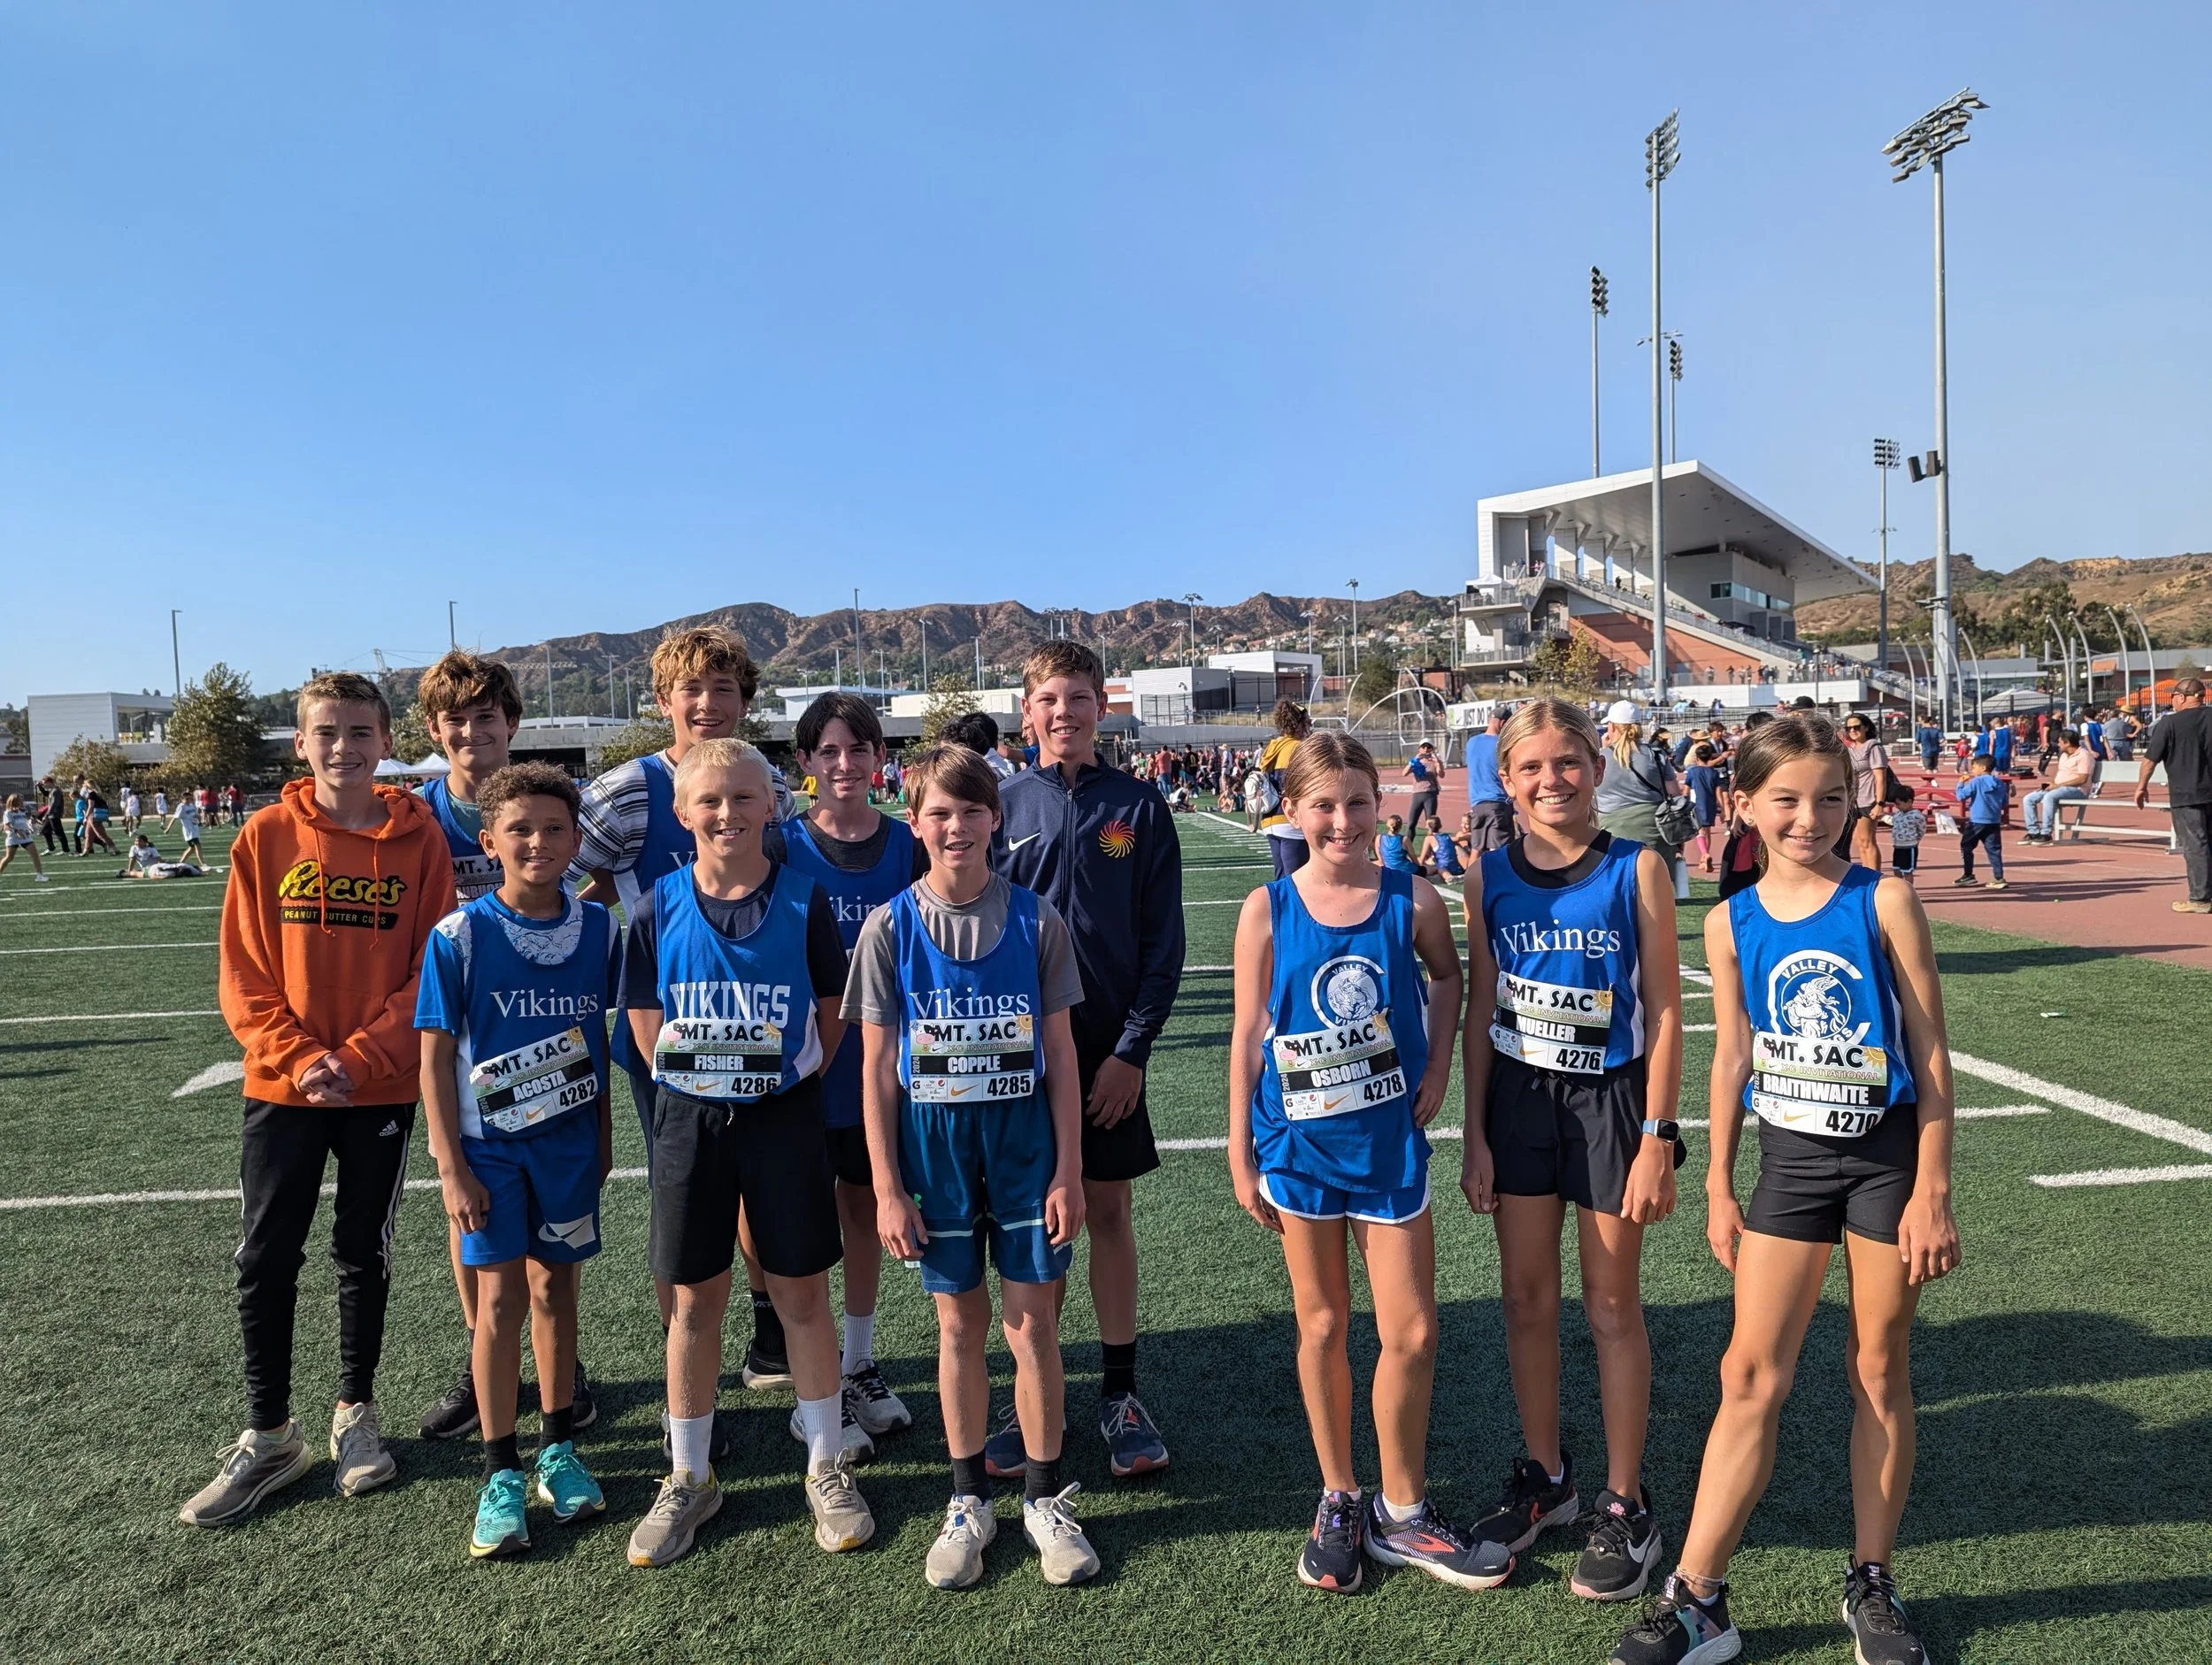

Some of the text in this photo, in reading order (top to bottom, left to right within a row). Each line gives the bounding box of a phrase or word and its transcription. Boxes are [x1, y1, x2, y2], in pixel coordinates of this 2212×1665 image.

[1463, 709, 1475, 725] JUST
[1478, 708, 1485, 725] DO
[362, 915, 386, 925] CUS
[1501, 919, 1621, 958] Vikings
[1332, 964, 1369, 975] VALLEY
[1781, 960, 1839, 978] VALLEY
[490, 988, 599, 1021] Vikings
[669, 981, 791, 1029] VIKINGS
[909, 987, 1030, 1019] Vikings
[1512, 981, 1594, 1012] MT. SAC
[1516, 1014, 1576, 1042] MUELLER
[1538, 1007, 1604, 1024] INVITATIONAL
[680, 1023, 764, 1042] MT. SAC
[934, 1022, 1017, 1042] MT. SAC
[1295, 1024, 1377, 1057] MT. SAC
[491, 1037, 572, 1078] MT. SAC
[966, 1040, 1031, 1052] INVITATIONAL
[1328, 1039, 1390, 1064] INVITATIONAL
[1555, 1048, 1601, 1070] 4276
[1770, 1040, 1863, 1068] MT. SAC
[527, 1049, 585, 1078] INVITATIONAL
[695, 1055, 744, 1071] FISHER
[947, 1055, 1002, 1074] COPPLE
[1310, 1059, 1372, 1088] OSBORN
[1799, 1065, 1881, 1081] INVITATIONAL
[512, 1070, 567, 1102] ACOSTA
[559, 1078, 597, 1108] 4282
[731, 1077, 778, 1094] 4286
[987, 1074, 1032, 1097] 4285
[1363, 1073, 1402, 1102] 4278
[1763, 1072, 1869, 1105] BRAITHWAITE
